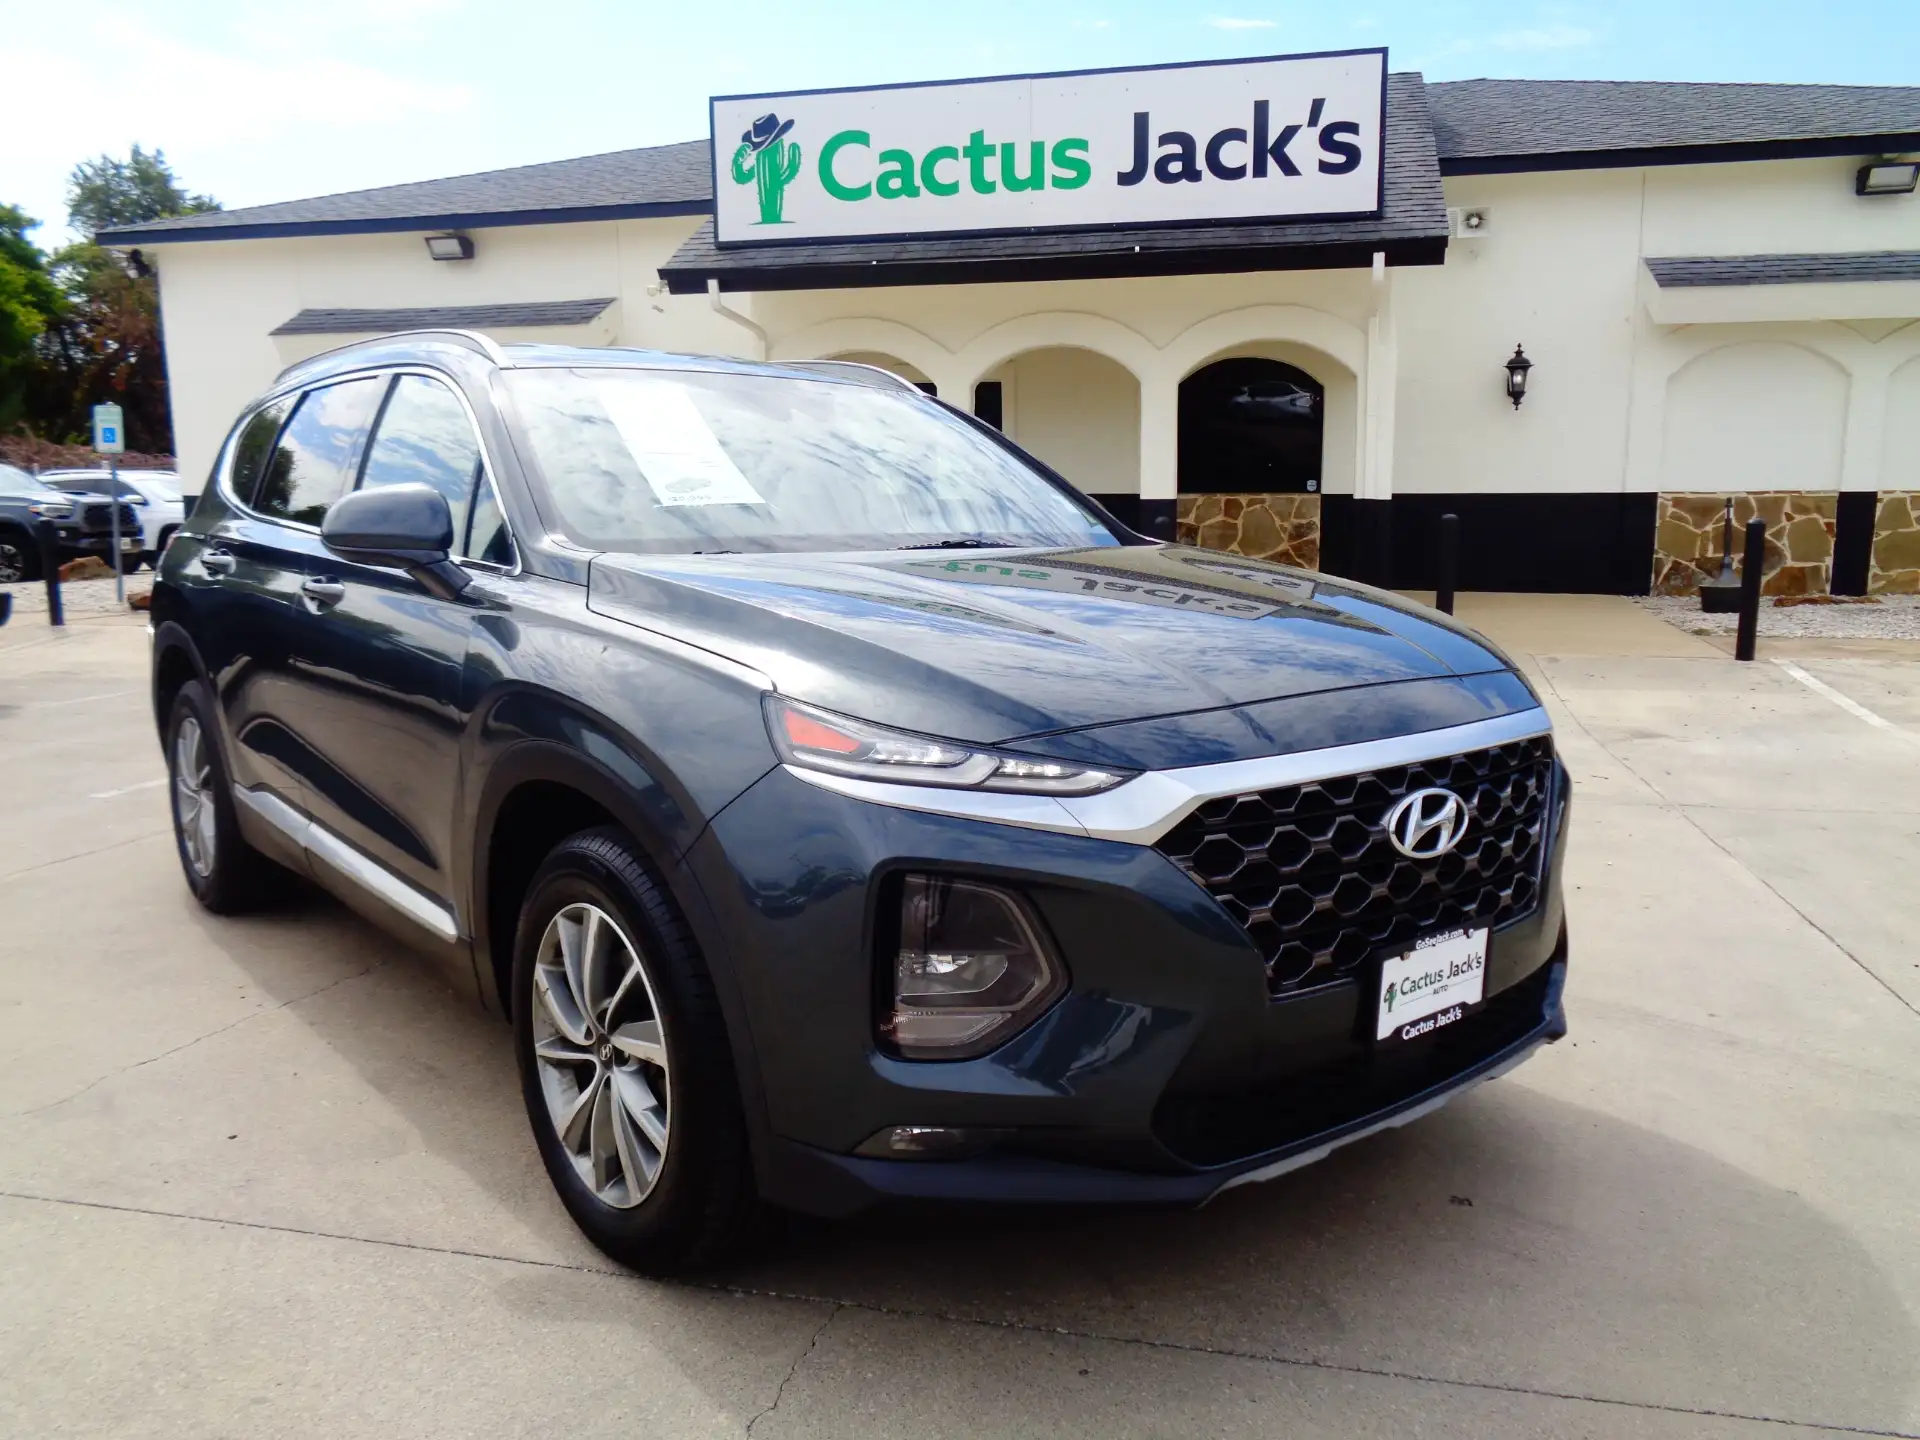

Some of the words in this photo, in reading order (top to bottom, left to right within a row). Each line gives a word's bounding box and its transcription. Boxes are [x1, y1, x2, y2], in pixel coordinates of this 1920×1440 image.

[818, 128, 1092, 202] Cactus
[1116, 97, 1362, 187] Jack's
[1400, 968, 1445, 996] Cactus
[1447, 952, 1482, 978] Jack's
[1433, 984, 1448, 996] AUTO
[1402, 1020, 1434, 1040] Cactus
[1436, 1007, 1462, 1027] Jack's
